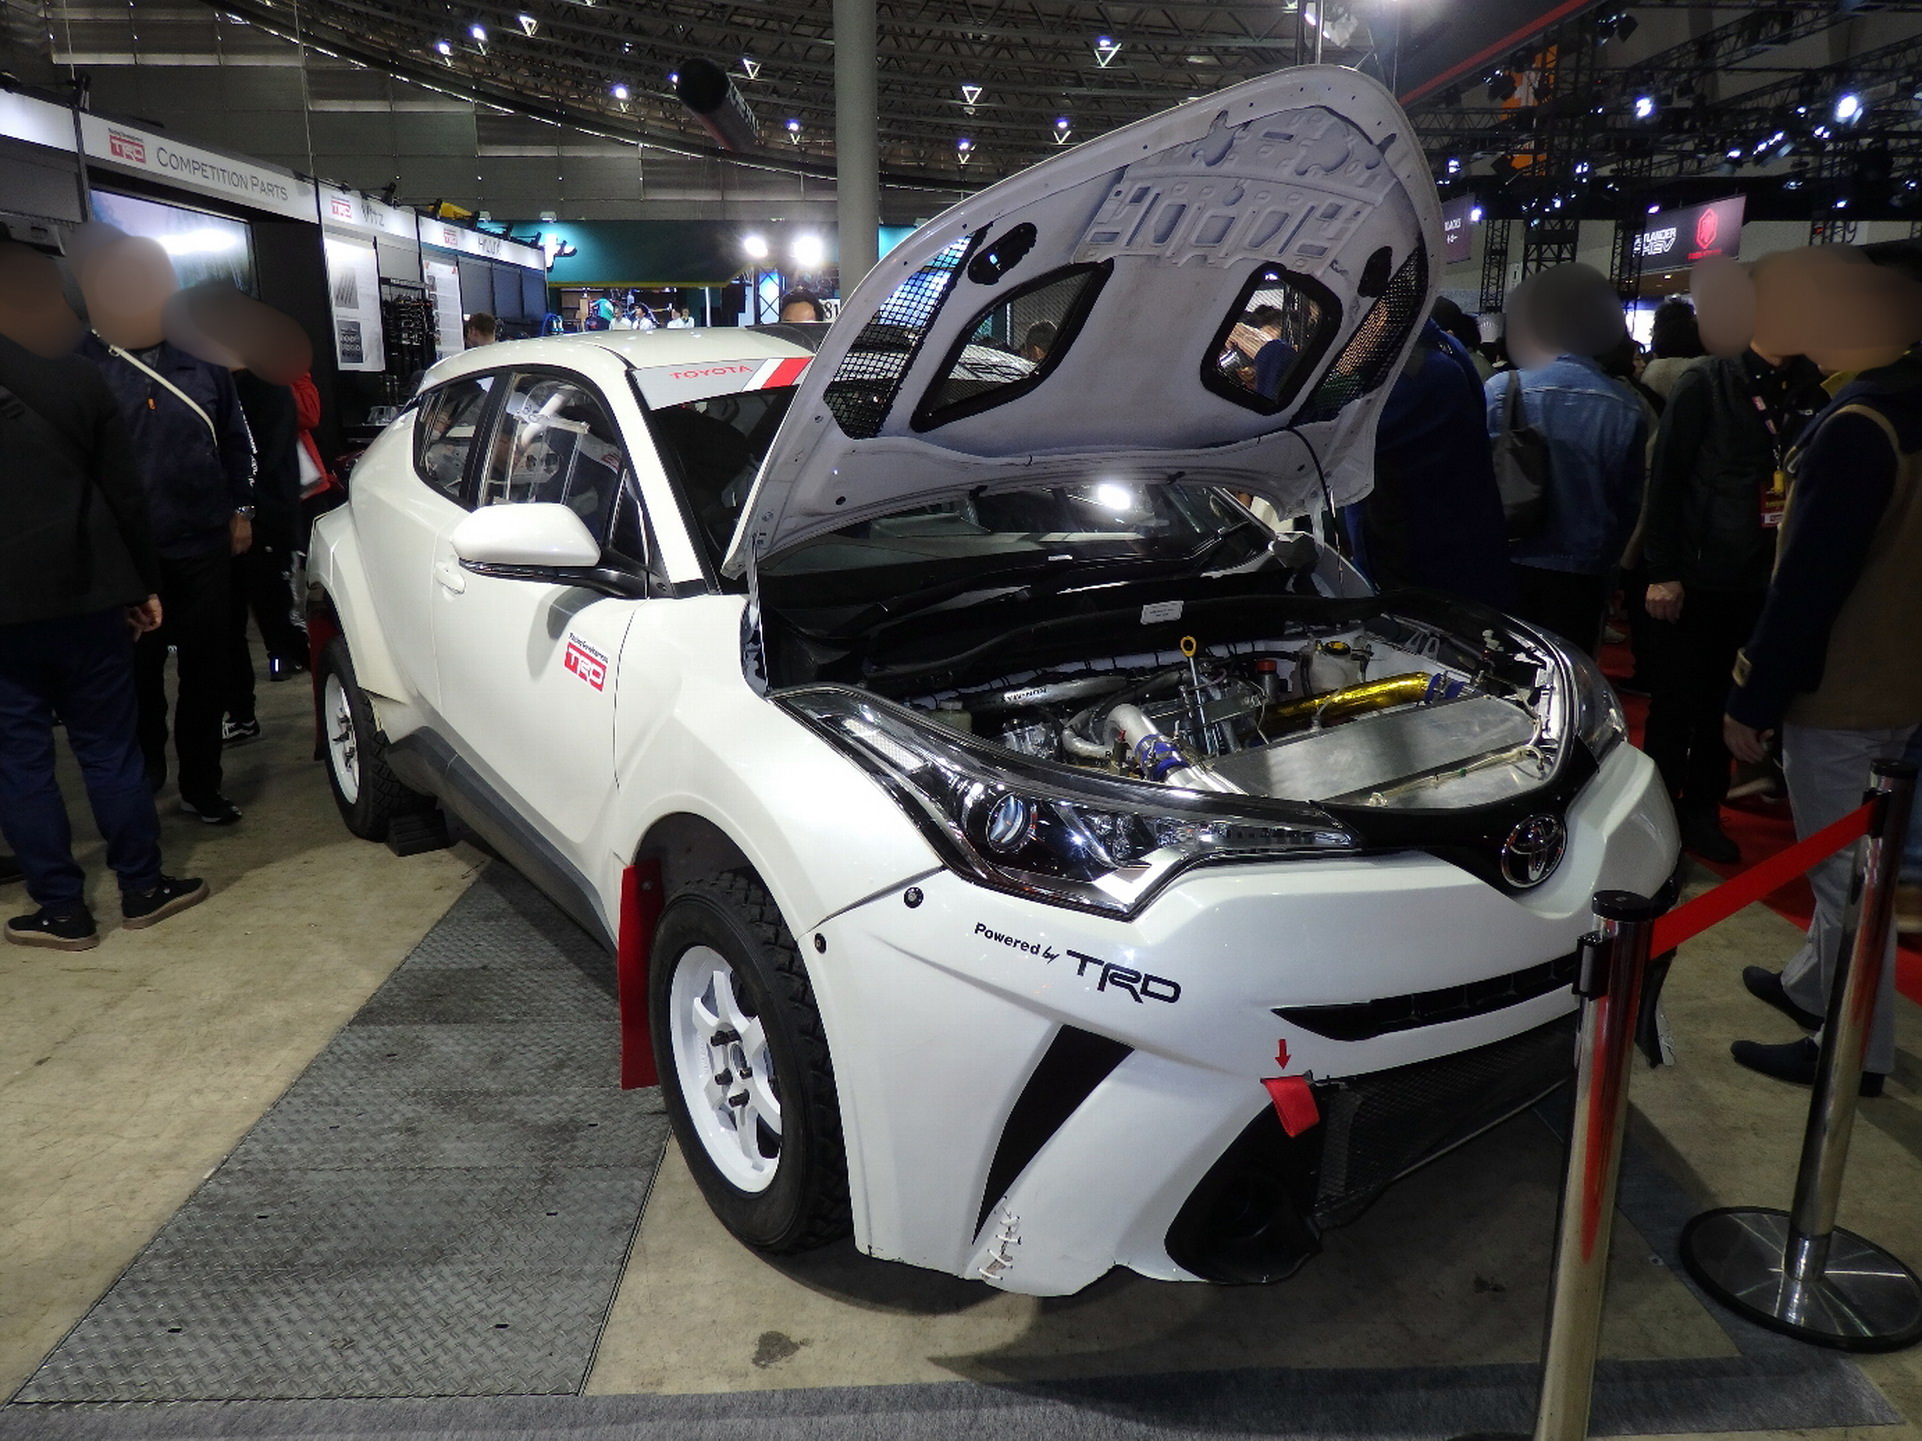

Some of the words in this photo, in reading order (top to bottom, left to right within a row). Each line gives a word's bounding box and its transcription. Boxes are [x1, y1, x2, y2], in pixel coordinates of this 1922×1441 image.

[109, 134, 146, 164] TRD
[156, 146, 249, 191] COMPETITION
[250, 175, 289, 201] PARTS
[669, 365, 754, 380] TOYOTA
[564, 641, 607, 693] TRD
[974, 921, 1042, 956] Powered
[1041, 945, 1060, 965] by
[1066, 949, 1182, 1004] TRD
